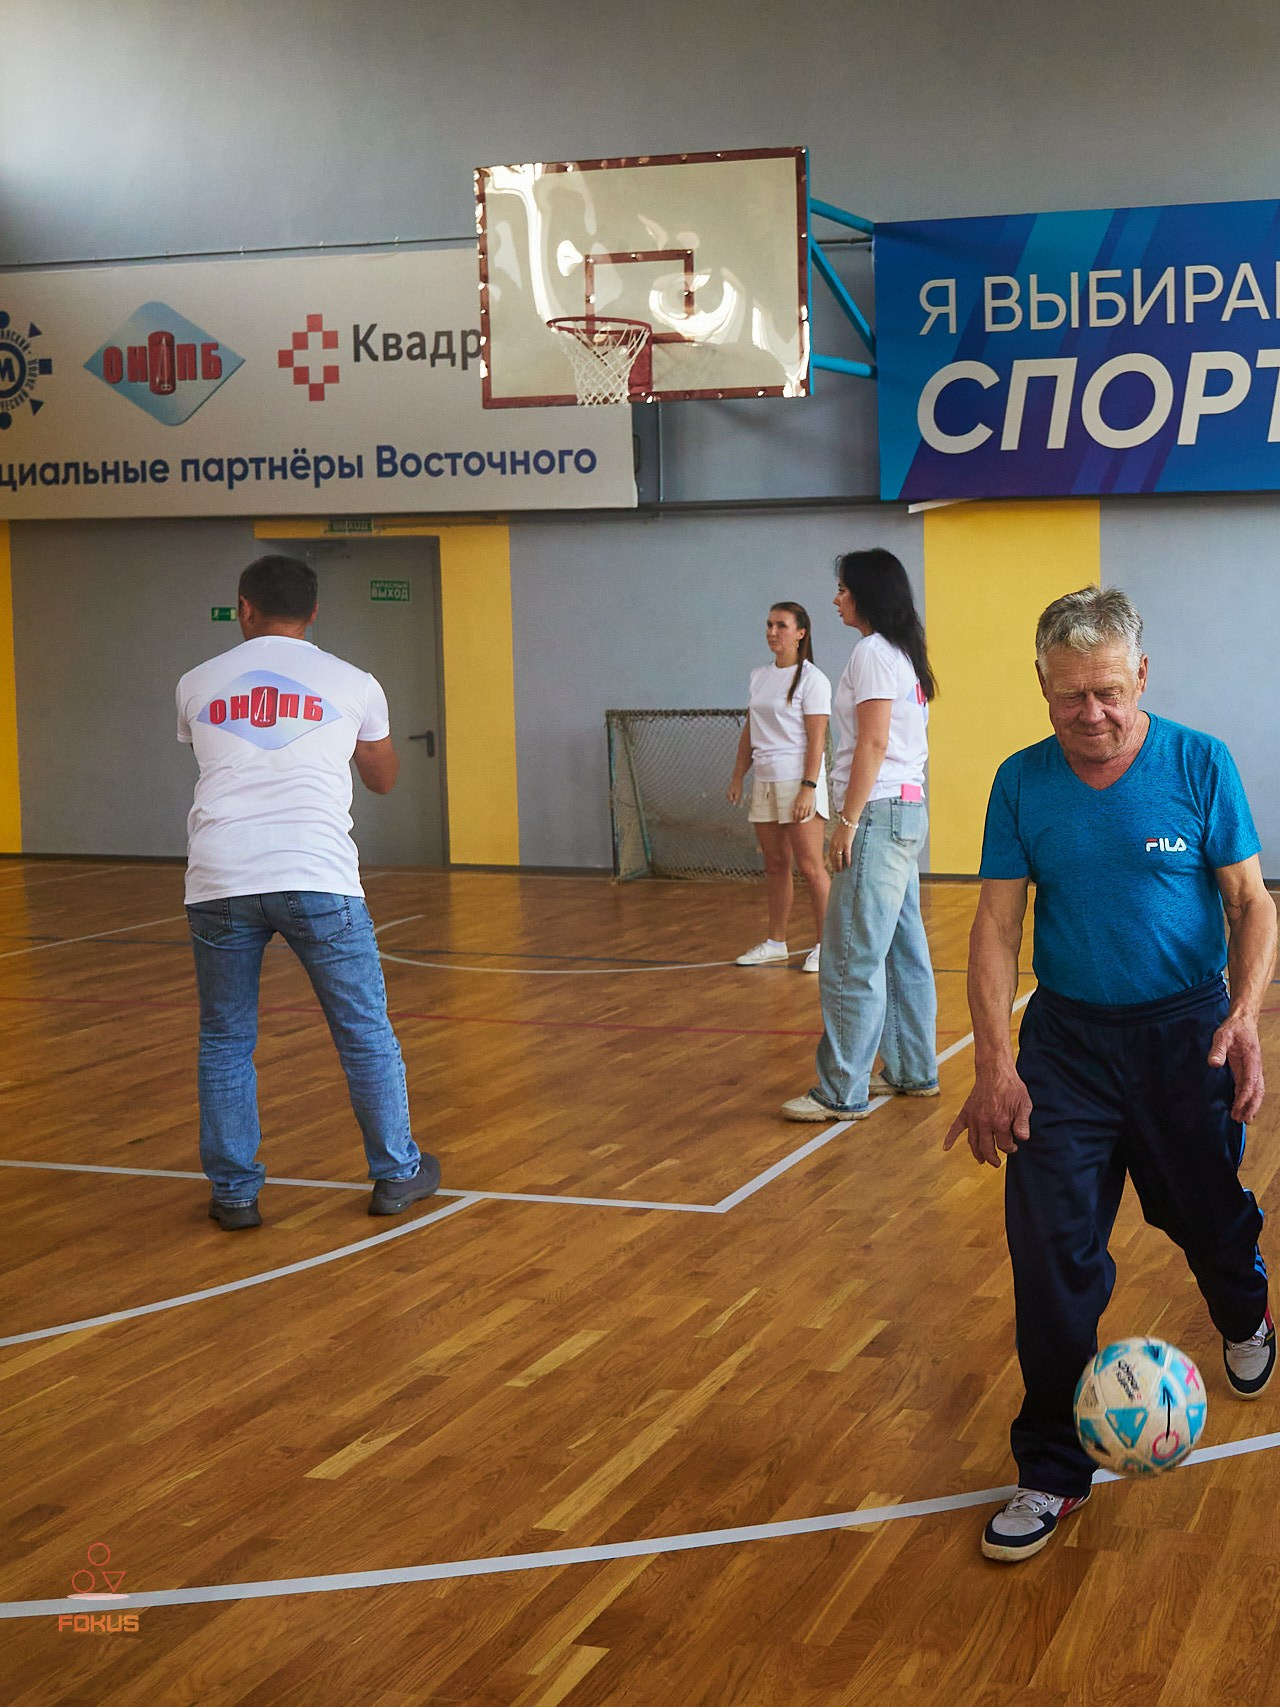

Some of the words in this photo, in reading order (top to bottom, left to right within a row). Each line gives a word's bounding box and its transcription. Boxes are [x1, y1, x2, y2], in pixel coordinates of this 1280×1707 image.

[918, 278, 957, 336] Я
[180, 447, 364, 490] партнёры
[375, 444, 598, 479] Восточного
[371, 587, 409, 600] ВЫХОД
[1145, 837, 1187, 852] FILA
